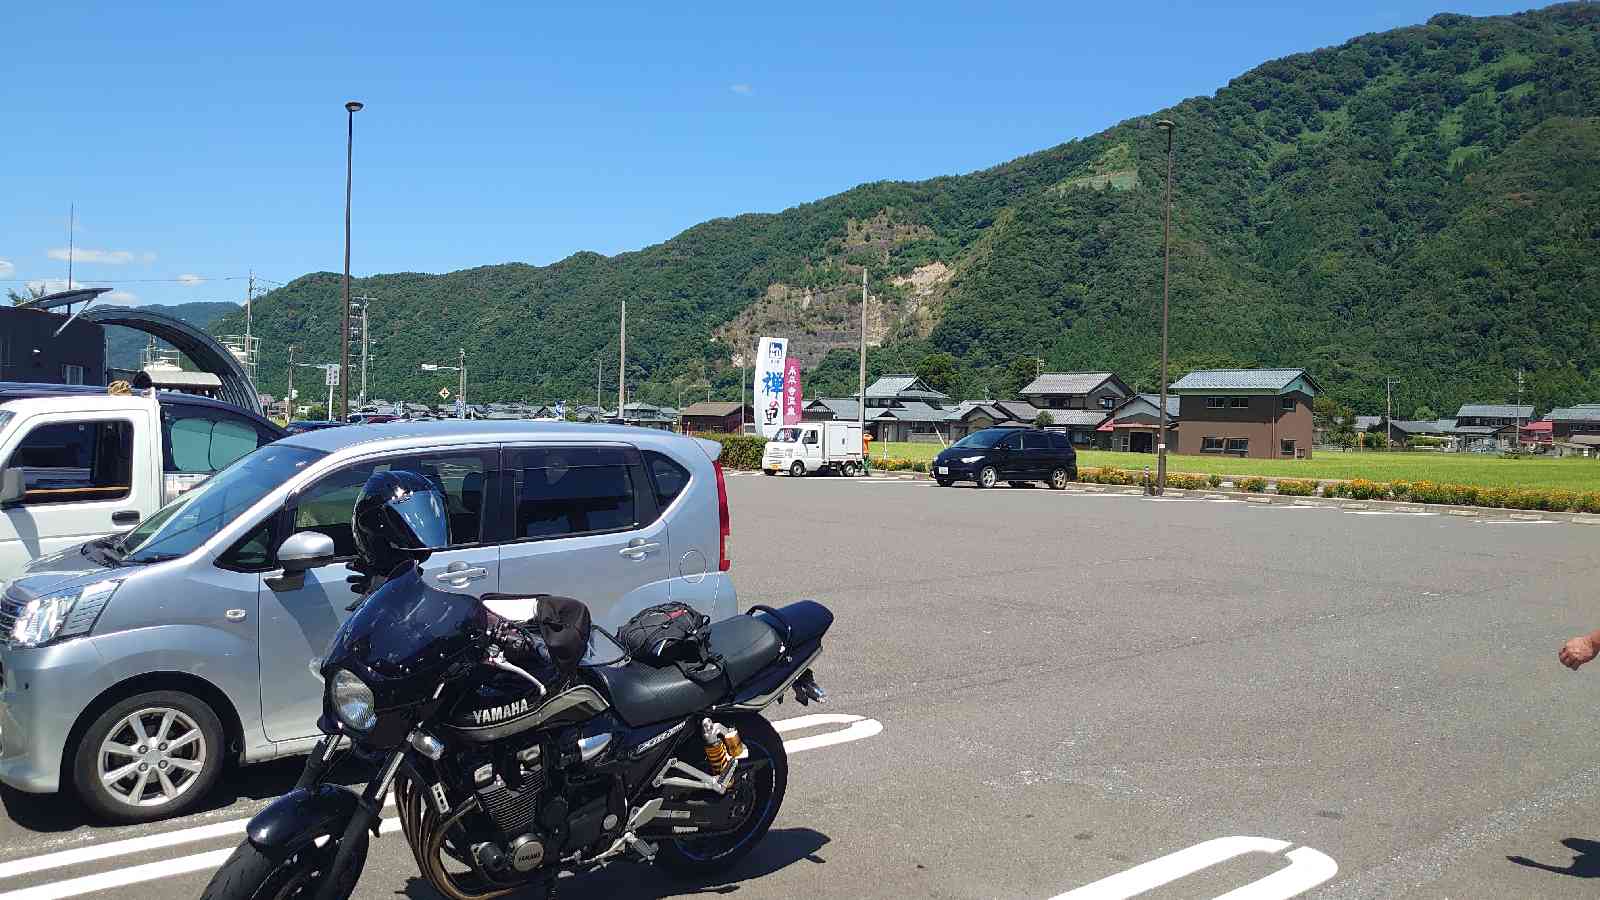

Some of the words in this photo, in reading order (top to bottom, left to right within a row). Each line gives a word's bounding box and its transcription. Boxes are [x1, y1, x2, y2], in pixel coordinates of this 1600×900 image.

[762, 371, 785, 425] 禅の里
[473, 698, 529, 724] YAMAHA
[518, 852, 541, 862] YAMAHA
